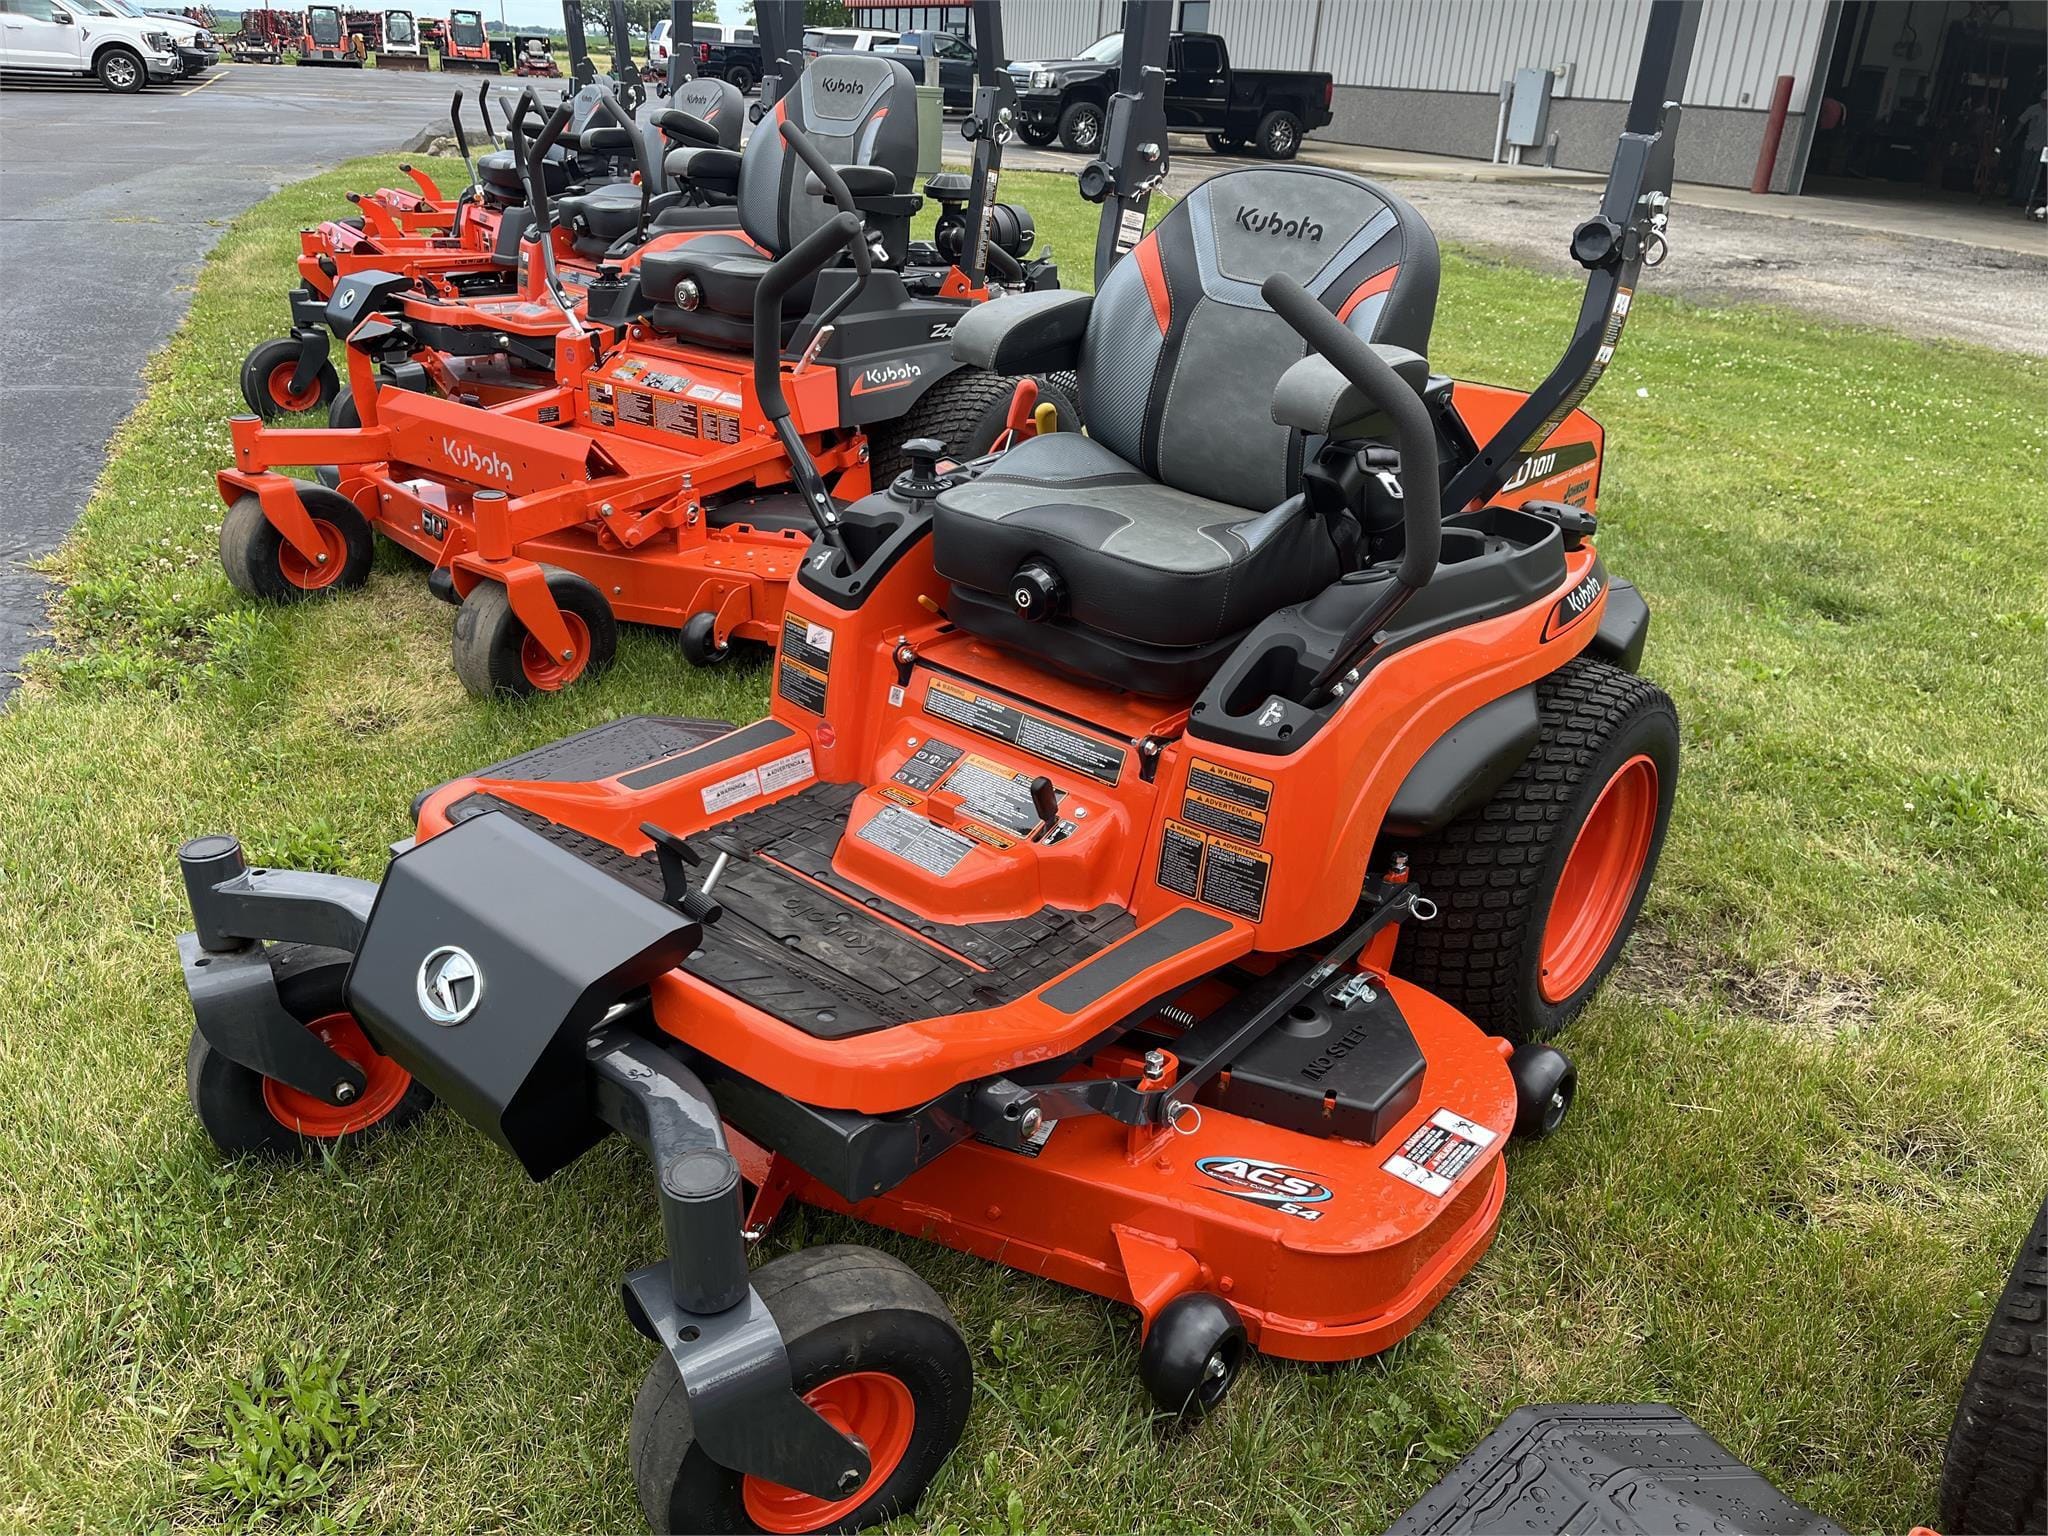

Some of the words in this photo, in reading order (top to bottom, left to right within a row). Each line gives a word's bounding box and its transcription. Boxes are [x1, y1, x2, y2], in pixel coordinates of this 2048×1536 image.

[822, 77, 864, 94] Kubota
[1236, 206, 1324, 242] Kubota
[866, 363, 922, 384] Kubota
[443, 437, 513, 481] Kubota
[1567, 576, 1601, 612] Kubota
[1217, 768, 1253, 785] WARNING
[1204, 797, 1254, 819] ADVERTENCIA
[1176, 824, 1202, 840] WARNING
[1222, 841, 1264, 860] ADVERTENCIA
[1301, 1056, 1335, 1082] NO
[1325, 1024, 1369, 1058] STEP
[1214, 1160, 1316, 1197] ACS
[1277, 1202, 1321, 1220] 54
